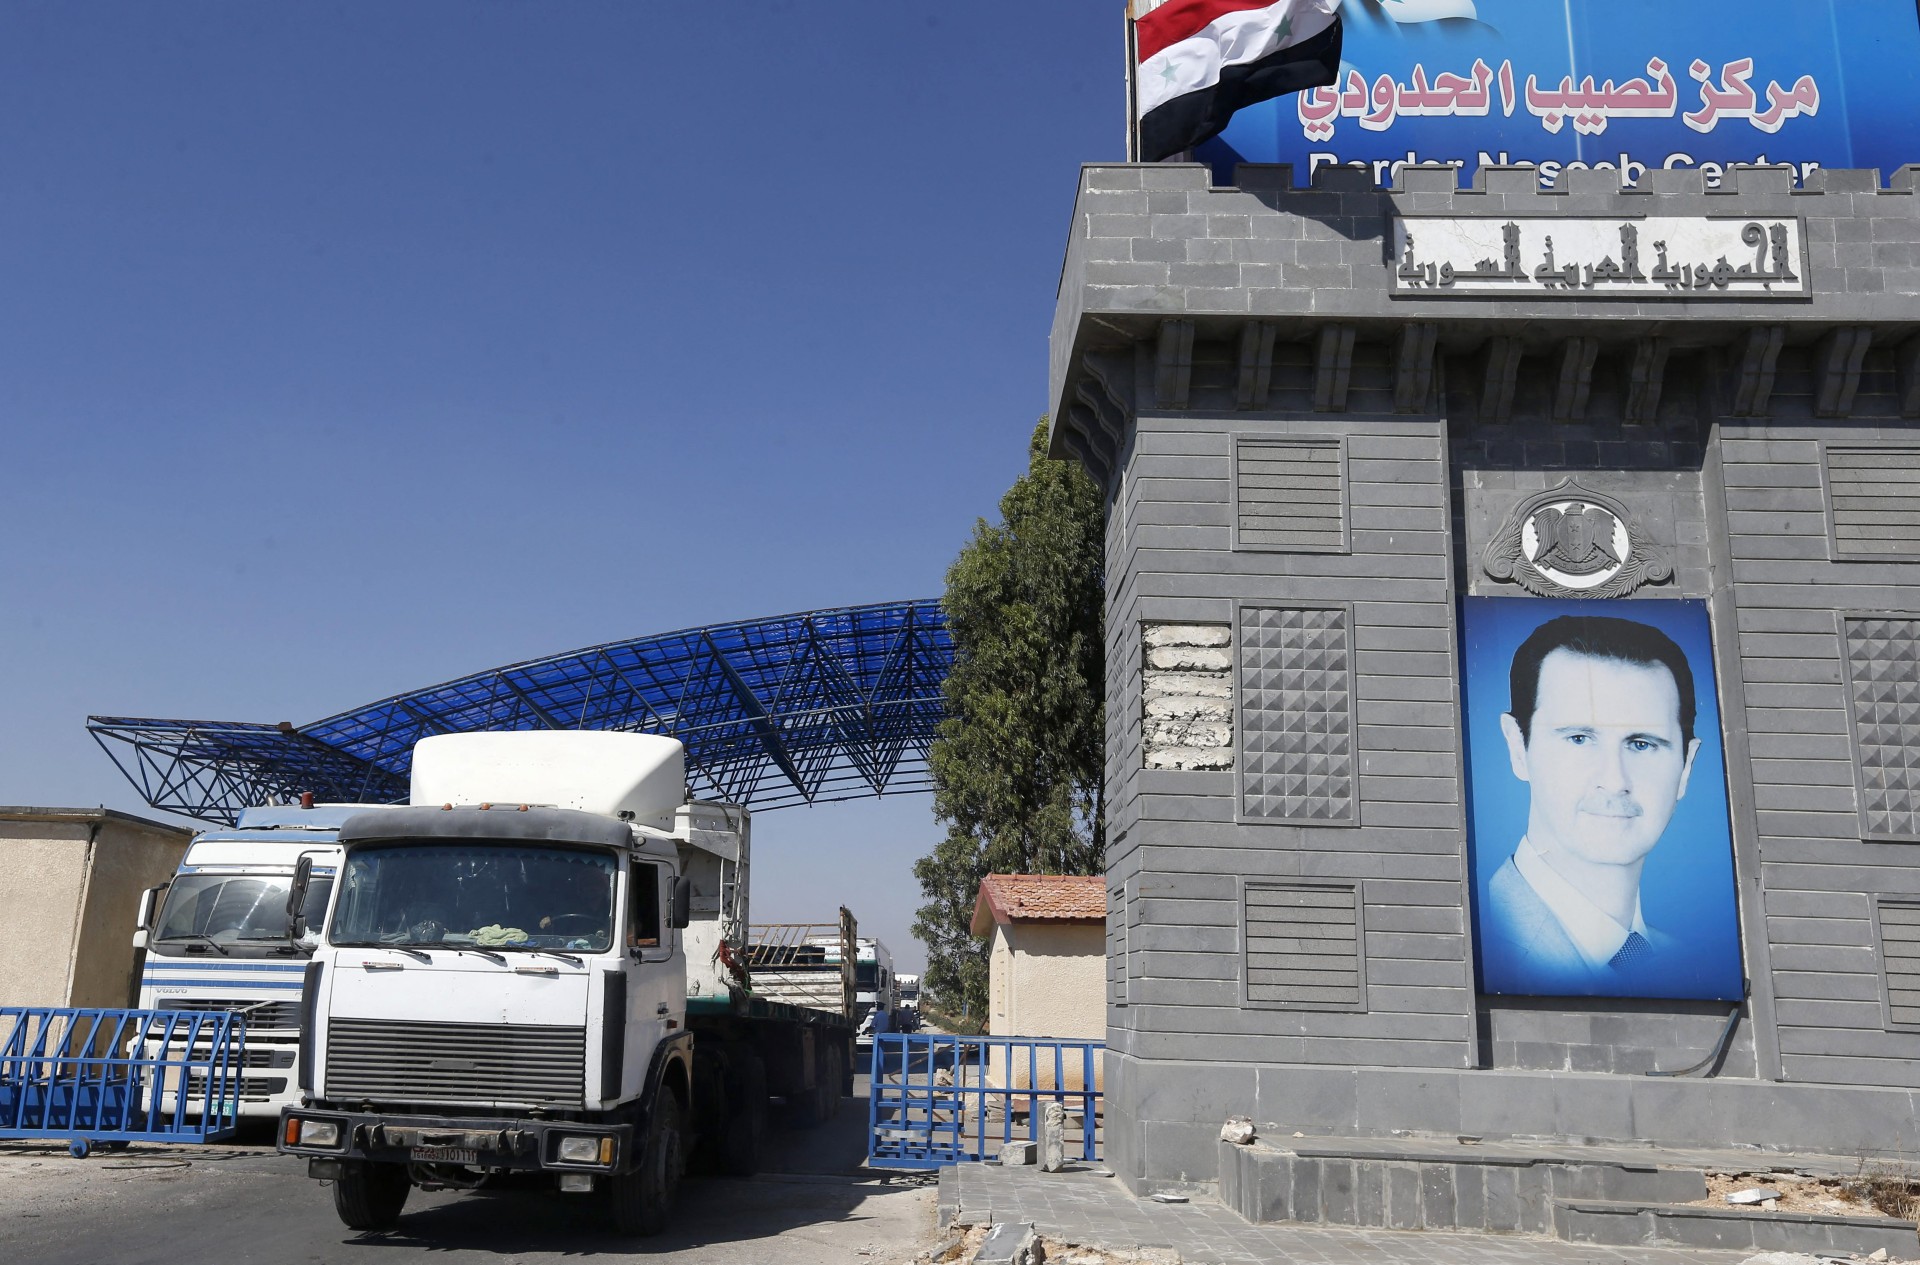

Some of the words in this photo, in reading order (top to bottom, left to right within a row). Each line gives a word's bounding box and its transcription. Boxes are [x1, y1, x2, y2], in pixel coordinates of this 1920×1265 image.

[1297, 57, 1516, 143] الحدودي
[1525, 56, 1678, 136] نصيب
[1682, 56, 1820, 134] مركز
[1398, 220, 1530, 289] السورية
[1533, 221, 1648, 290] العربية
[1652, 221, 1799, 291] الجمهورية
